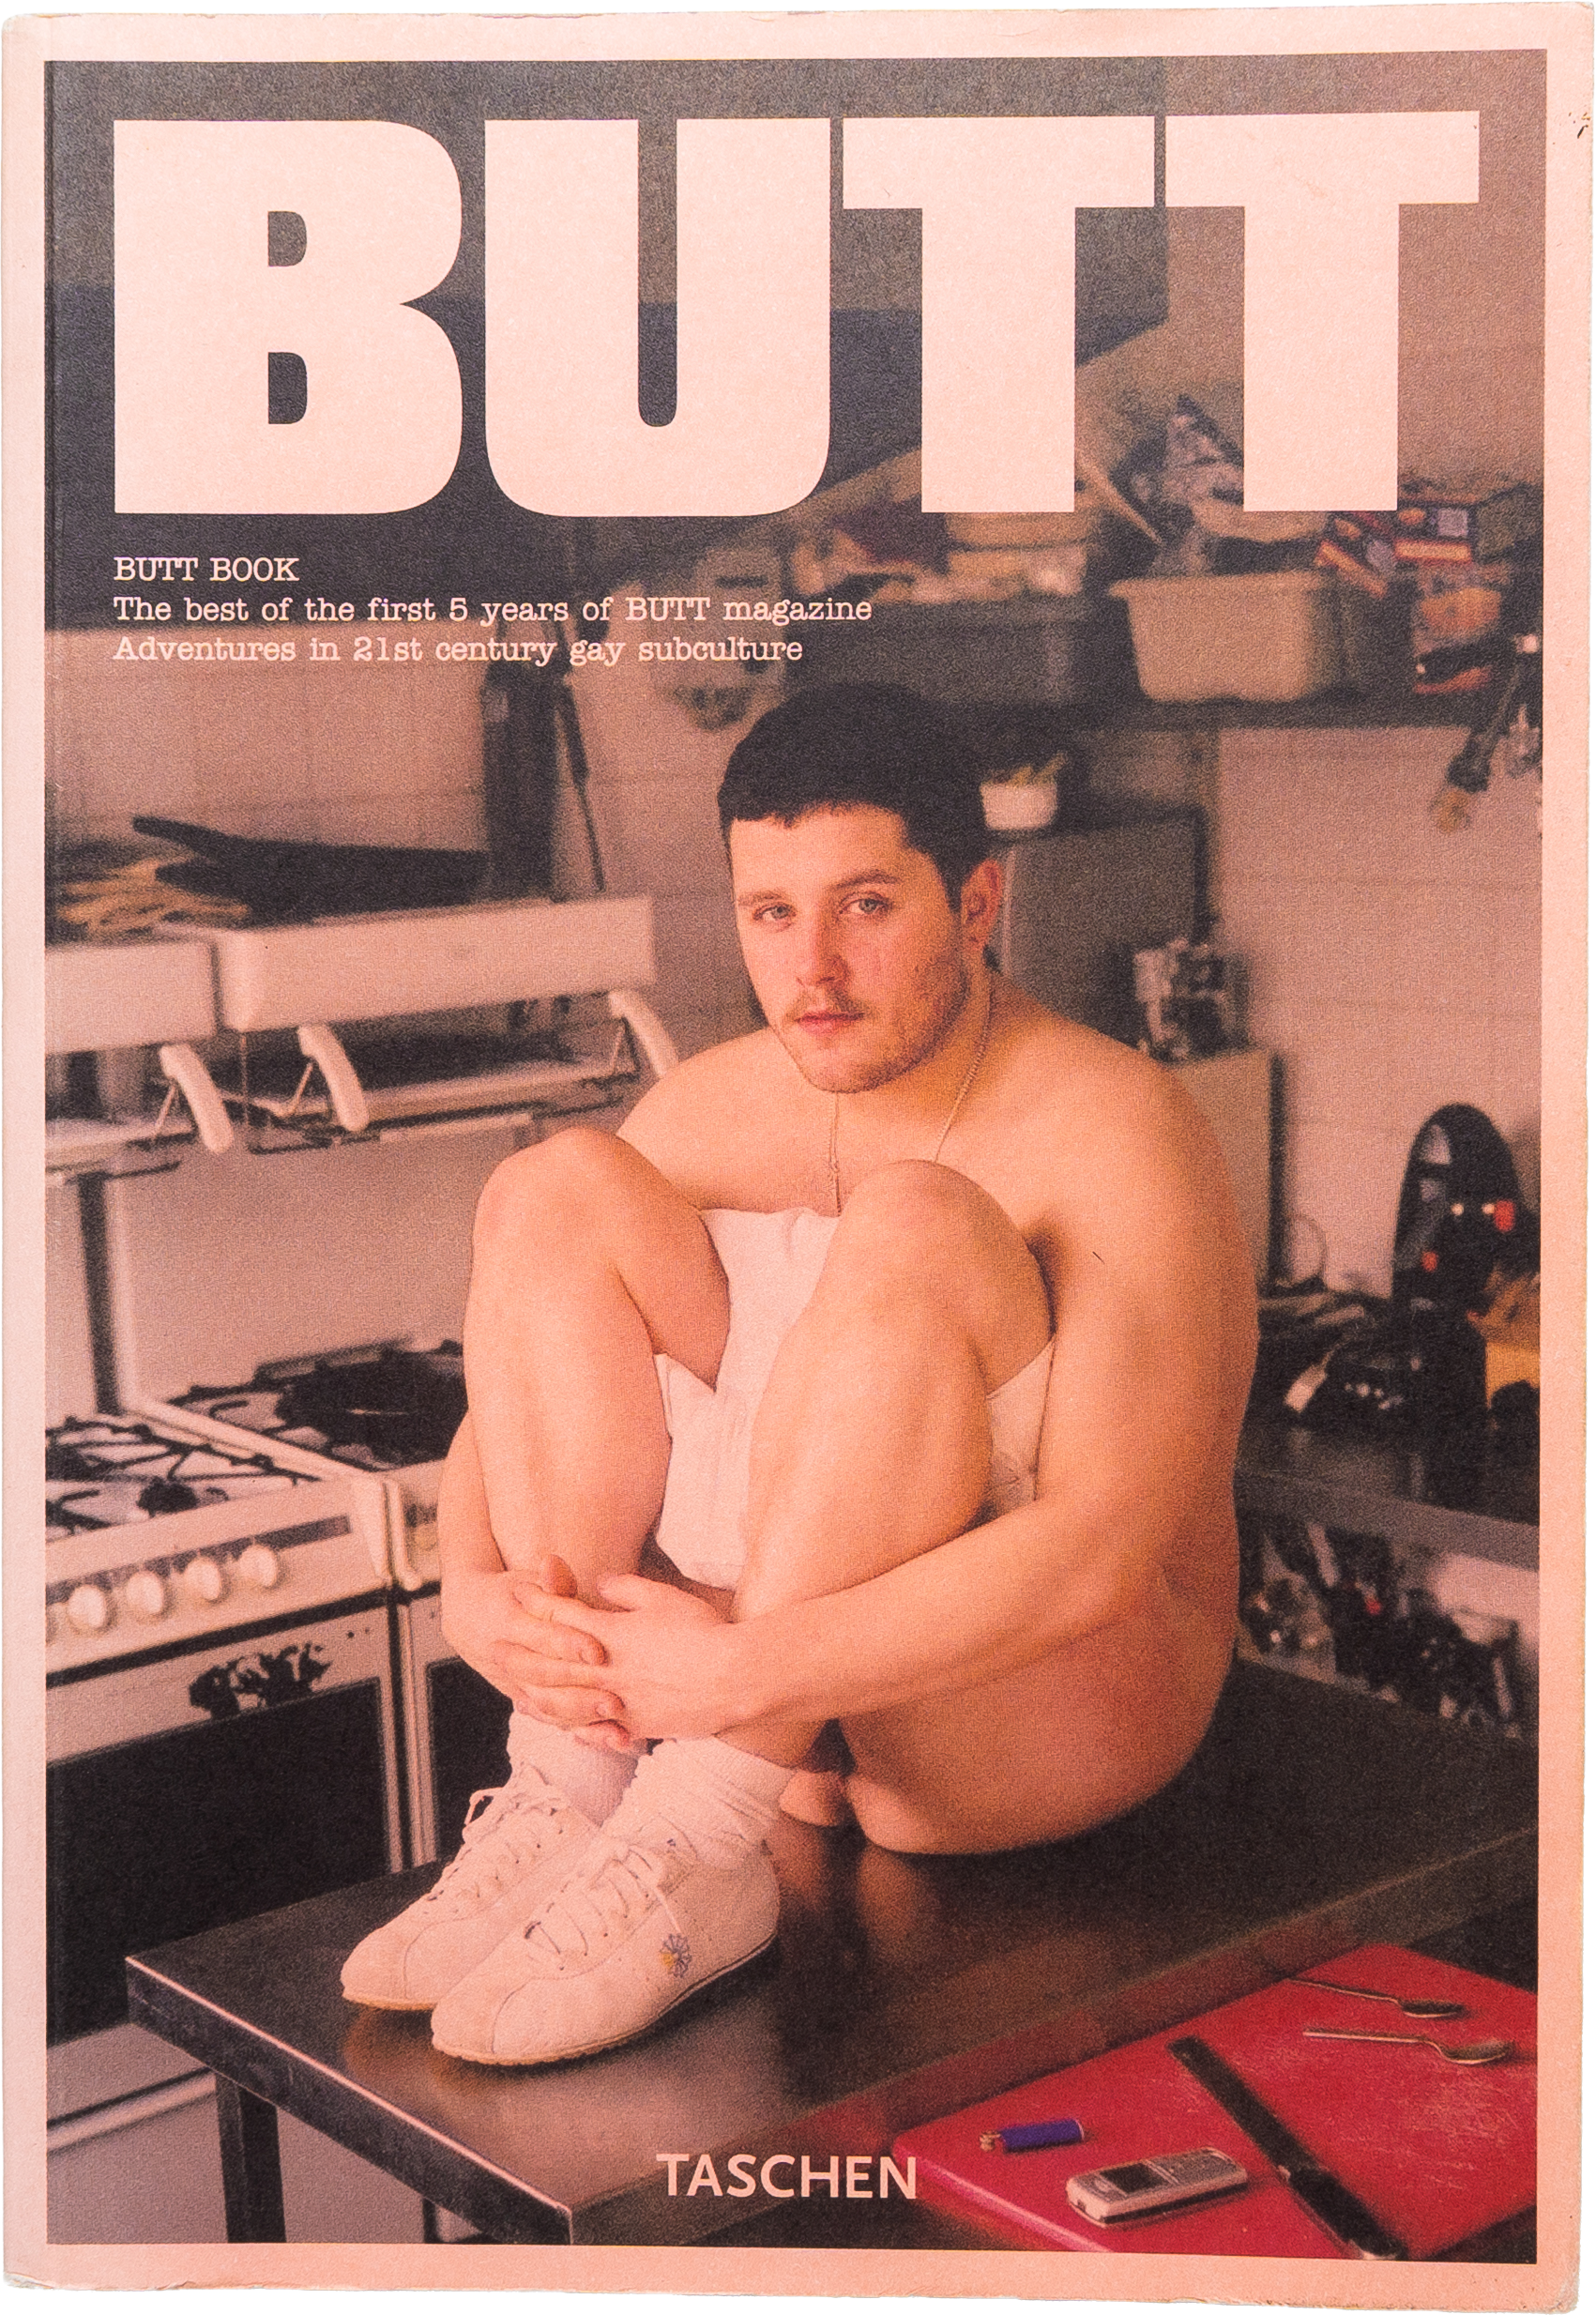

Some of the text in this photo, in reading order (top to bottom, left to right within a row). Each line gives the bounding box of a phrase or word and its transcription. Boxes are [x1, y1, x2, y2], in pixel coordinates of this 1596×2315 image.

[114, 110, 1481, 516] BUTT
[113, 556, 299, 582] BUTT BOOK
[113, 596, 873, 627] The best of the first 5 years of BUTT magazine
[112, 636, 803, 667] Adventures in 21st century gay subculture
[656, 2153, 918, 2201] TASCHEN
